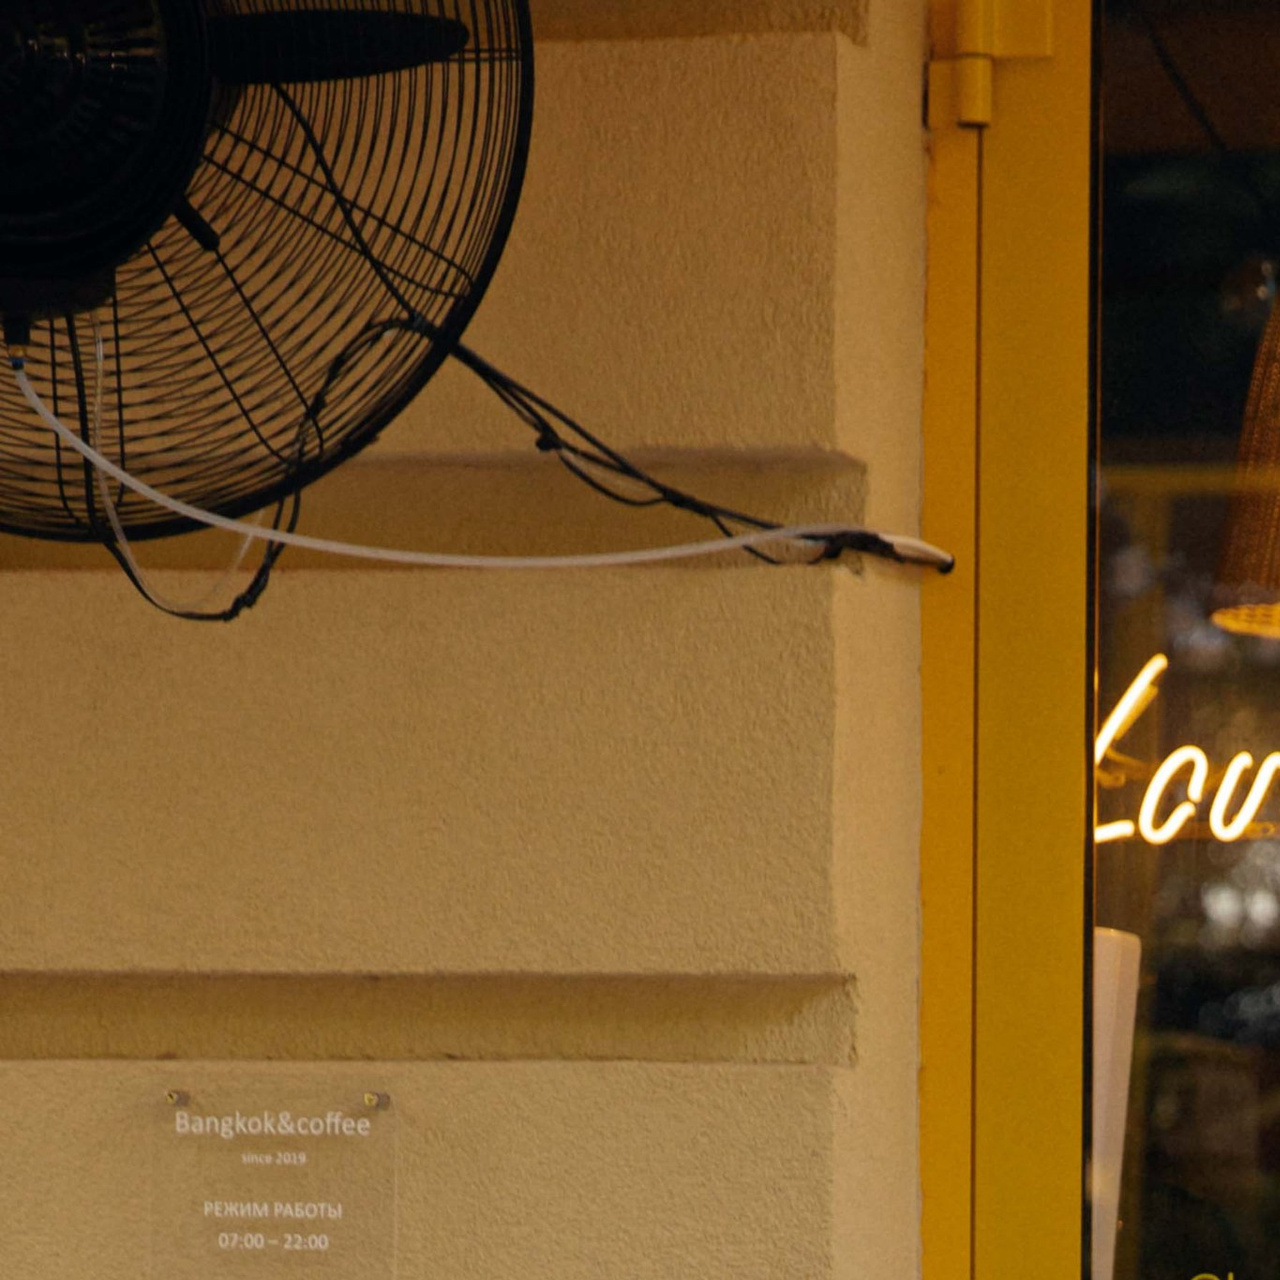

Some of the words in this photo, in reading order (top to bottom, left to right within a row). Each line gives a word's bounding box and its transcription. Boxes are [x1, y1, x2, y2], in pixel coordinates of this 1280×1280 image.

[175, 1110, 371, 1139] Bangkok&coffee
[241, 1151, 273, 1165] since
[275, 1151, 307, 1166] 2019
[203, 1200, 269, 1218] РЕЖИМ
[273, 1202, 342, 1220] РАБОТЫ
[218, 1232, 264, 1249] 07:00
[283, 1233, 329, 1250] 22:00
